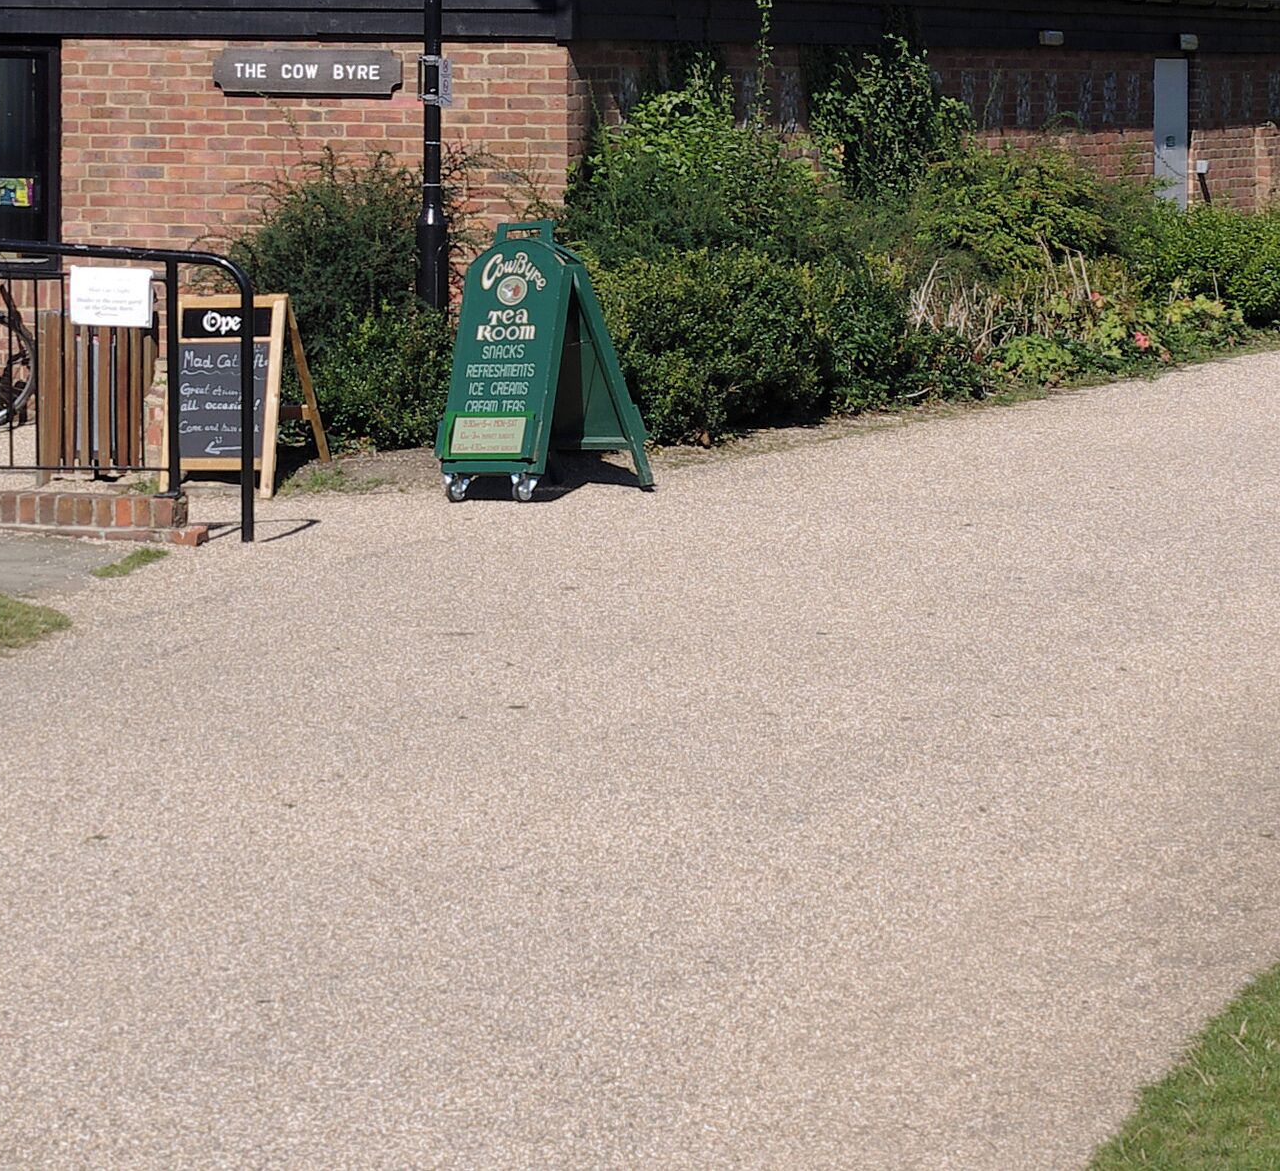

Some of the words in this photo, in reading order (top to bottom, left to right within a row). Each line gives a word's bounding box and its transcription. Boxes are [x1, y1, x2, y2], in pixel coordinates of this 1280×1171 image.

[234, 63, 267, 78] THE
[281, 63, 319, 79] COW
[333, 64, 381, 80] BYRE
[202, 310, 242, 335] Ope
[183, 350, 214, 368] Mad
[216, 353, 239, 368] Cat
[481, 344, 526, 359] SNACKS
[465, 363, 536, 378] REFRESHMENTS
[180, 382, 211, 397] Great
[468, 382, 485, 396] ICE
[490, 381, 529, 396] CREAMS
[180, 399, 199, 412] all
[464, 399, 499, 413] CREAM
[501, 399, 526, 413] TEAS
[179, 420, 203, 434] Come
[204, 423, 220, 432] and
